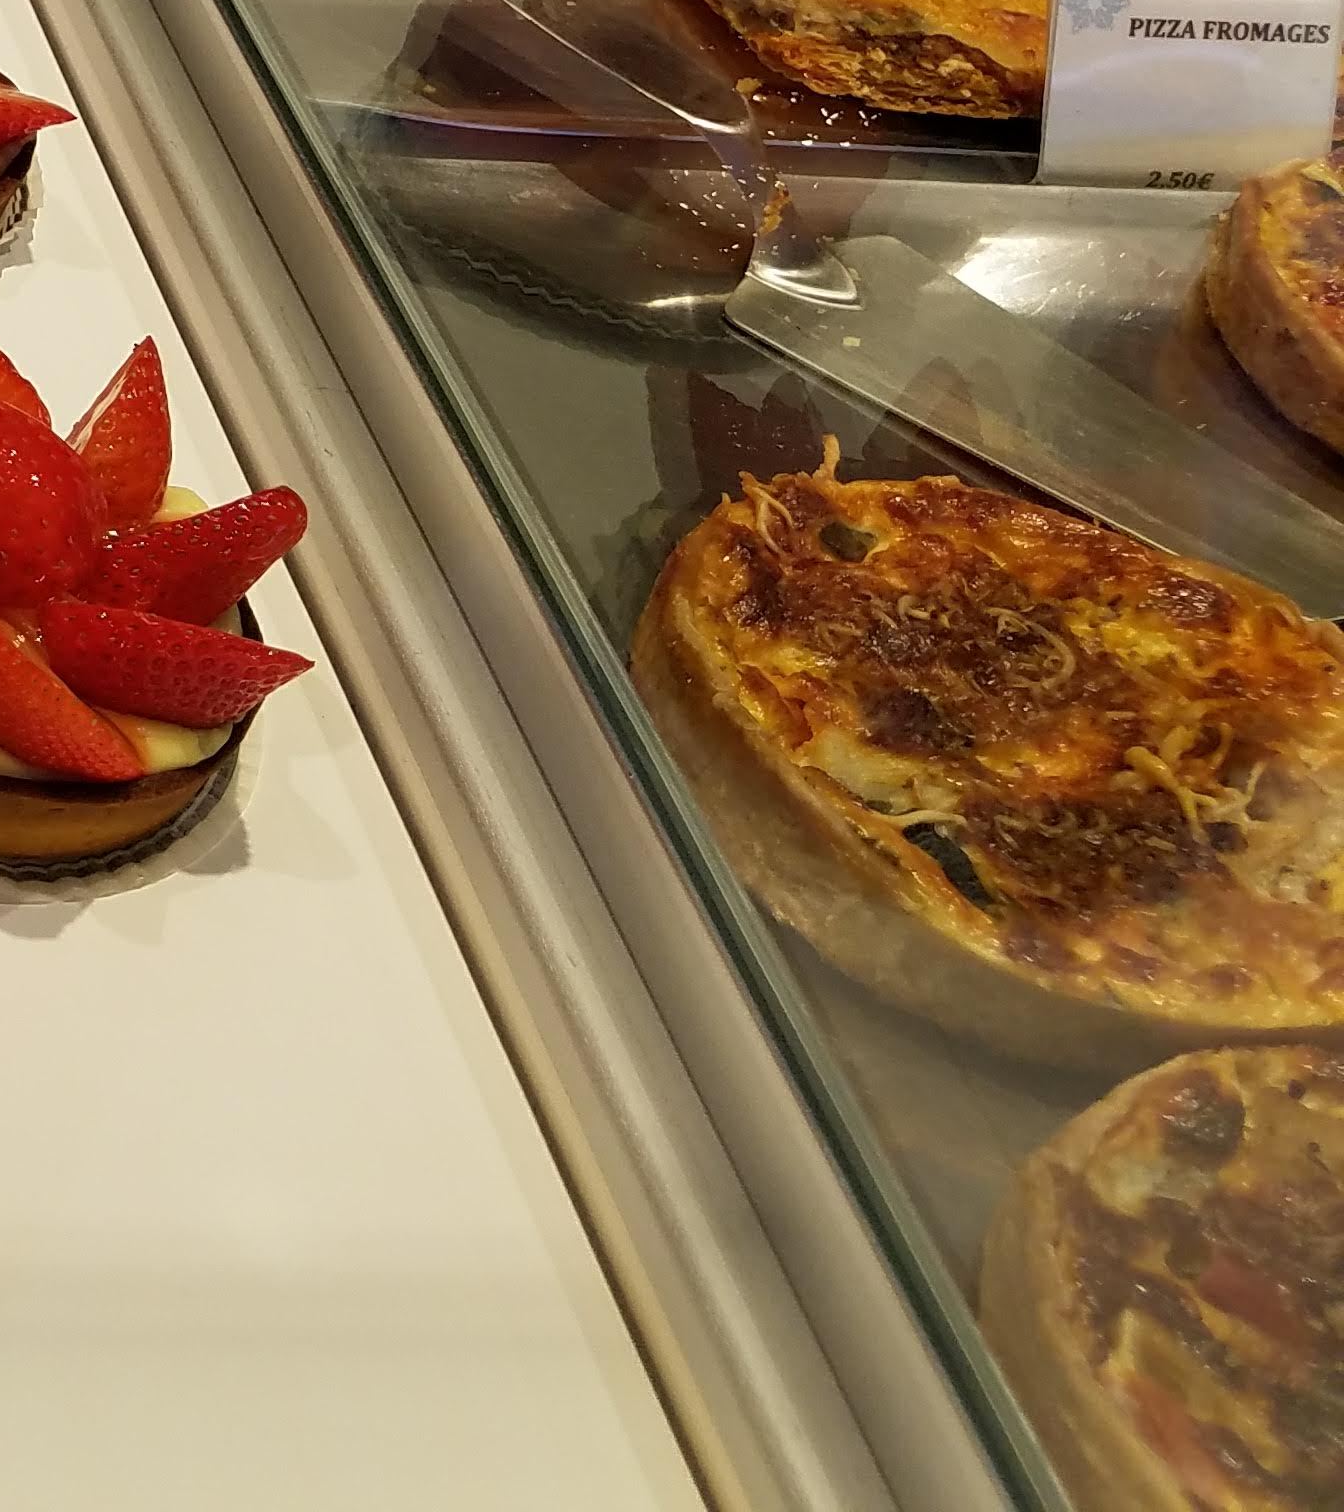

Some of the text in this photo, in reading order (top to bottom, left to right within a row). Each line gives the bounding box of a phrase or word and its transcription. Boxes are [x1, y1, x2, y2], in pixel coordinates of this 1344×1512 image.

[1128, 17, 1332, 45] PIZZA FROMAGES
[1144, 170, 1215, 190] 2.50€
